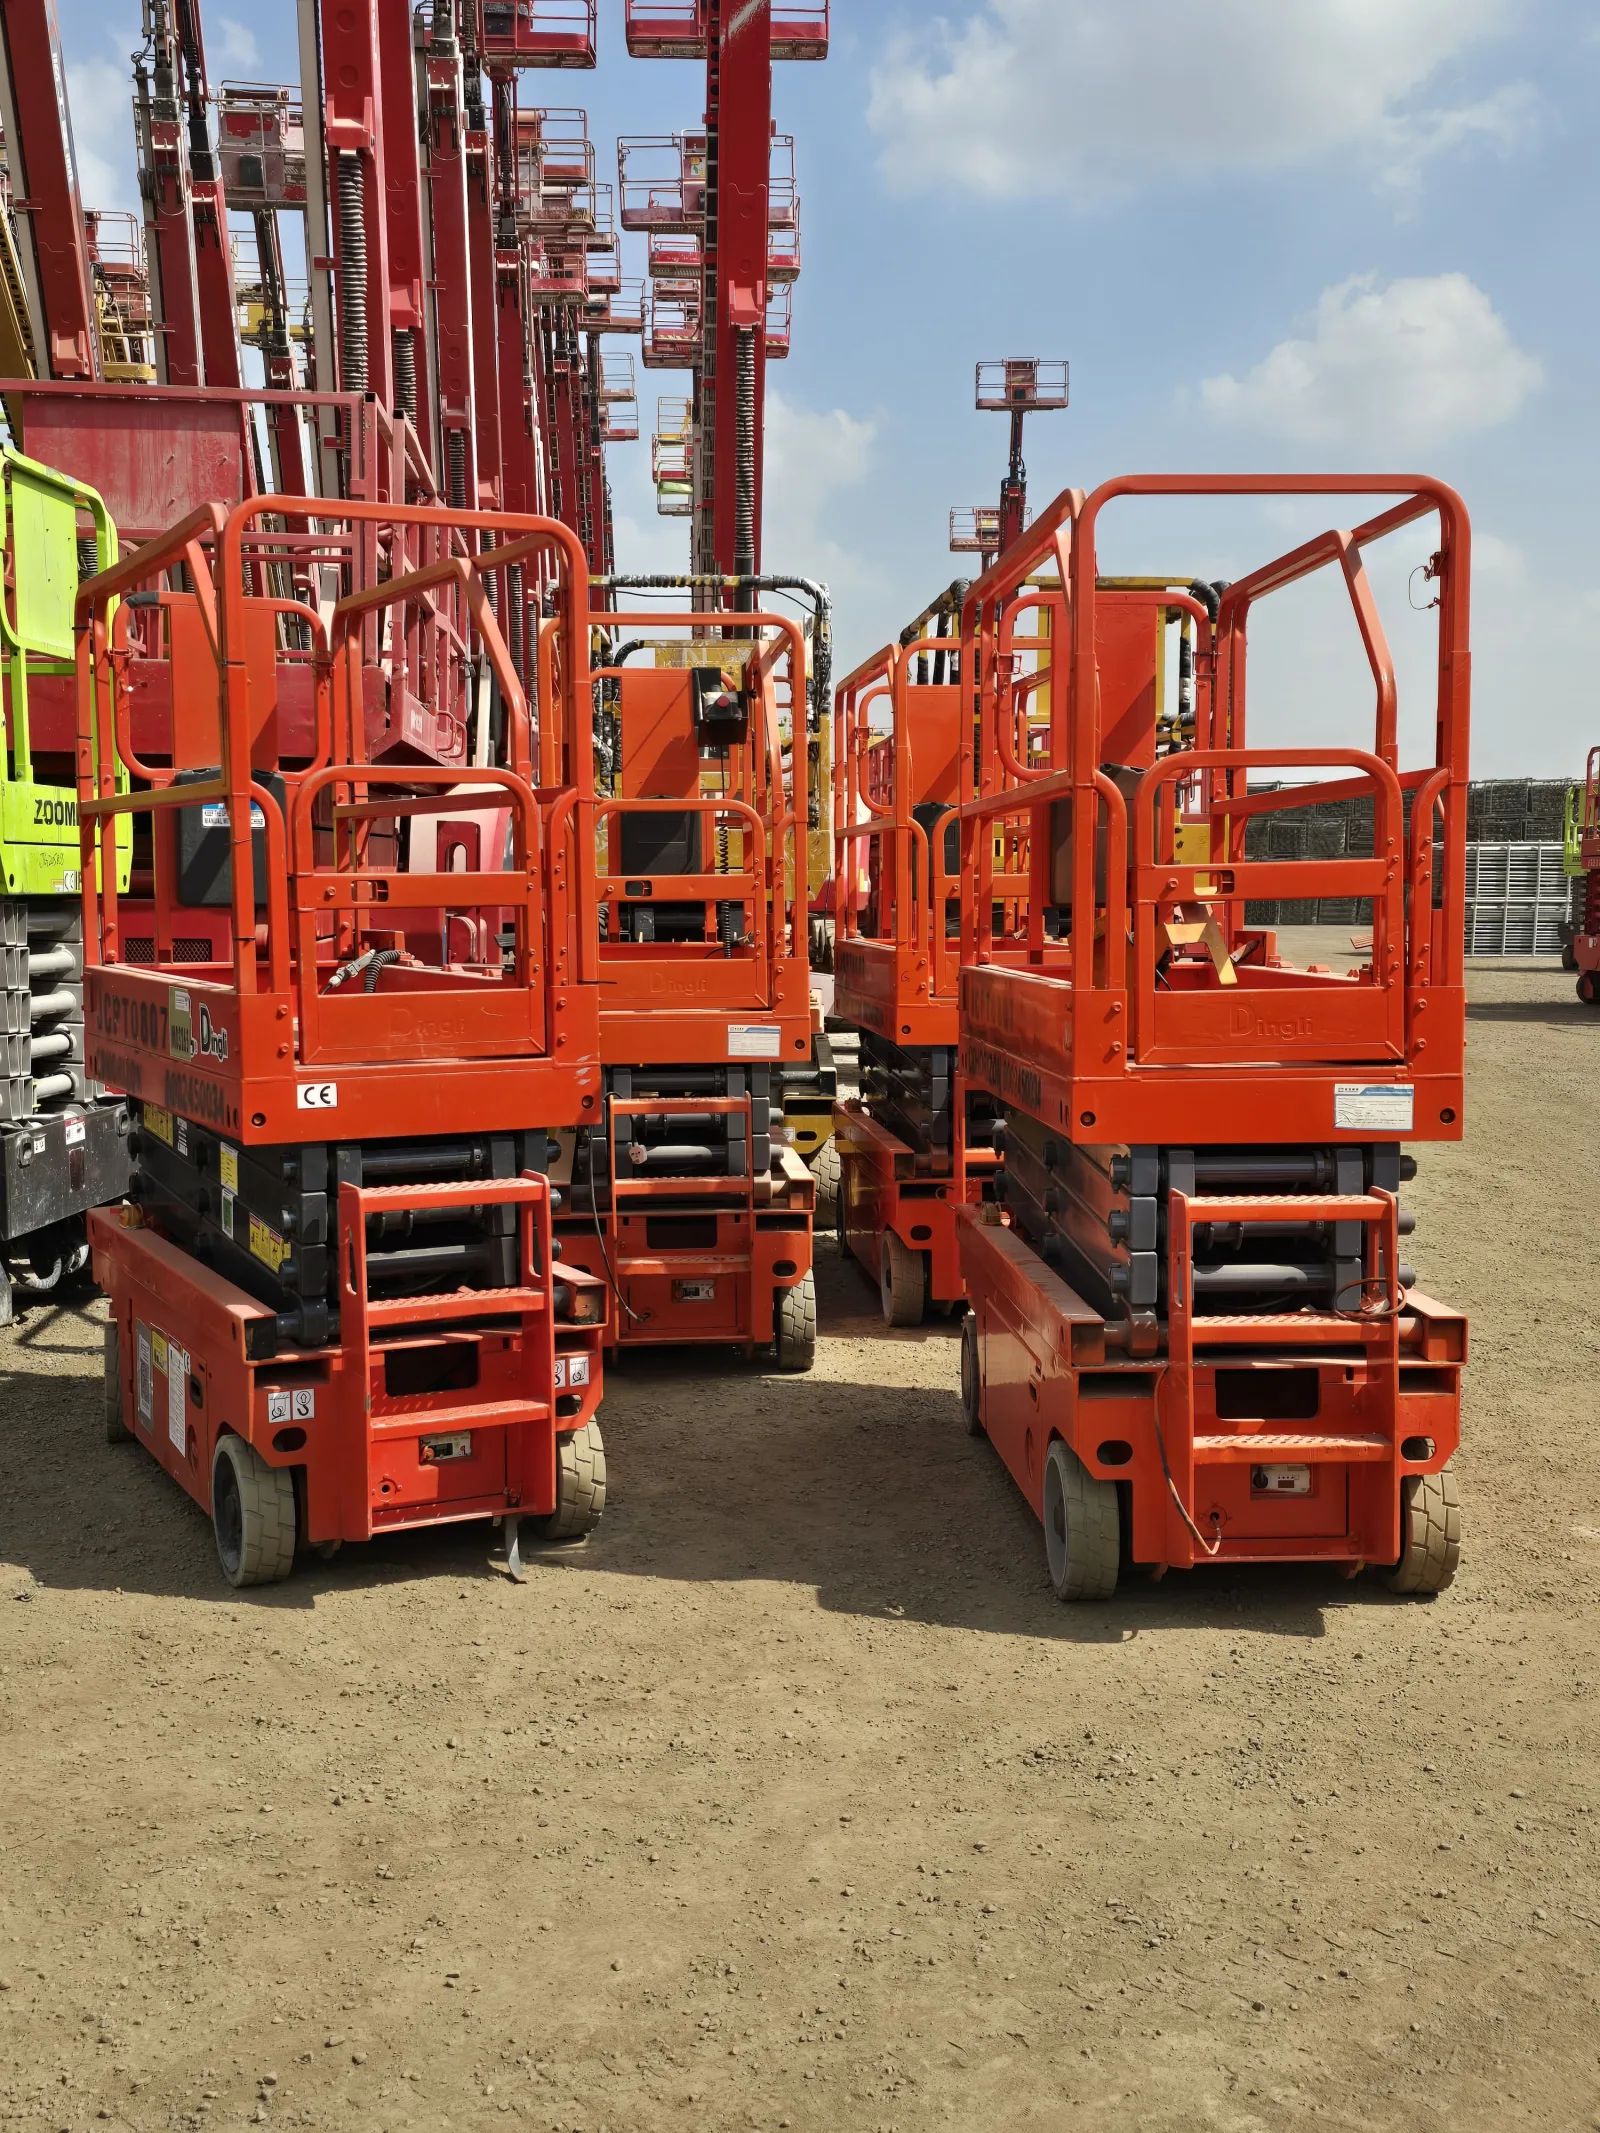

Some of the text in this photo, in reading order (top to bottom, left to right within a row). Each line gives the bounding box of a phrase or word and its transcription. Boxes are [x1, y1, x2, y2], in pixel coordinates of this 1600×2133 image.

[650, 972, 707, 996] Dingli
[199, 1004, 229, 1062] Dingli
[1229, 1003, 1313, 1041] Dingli
[304, 1085, 331, 1105] CE
